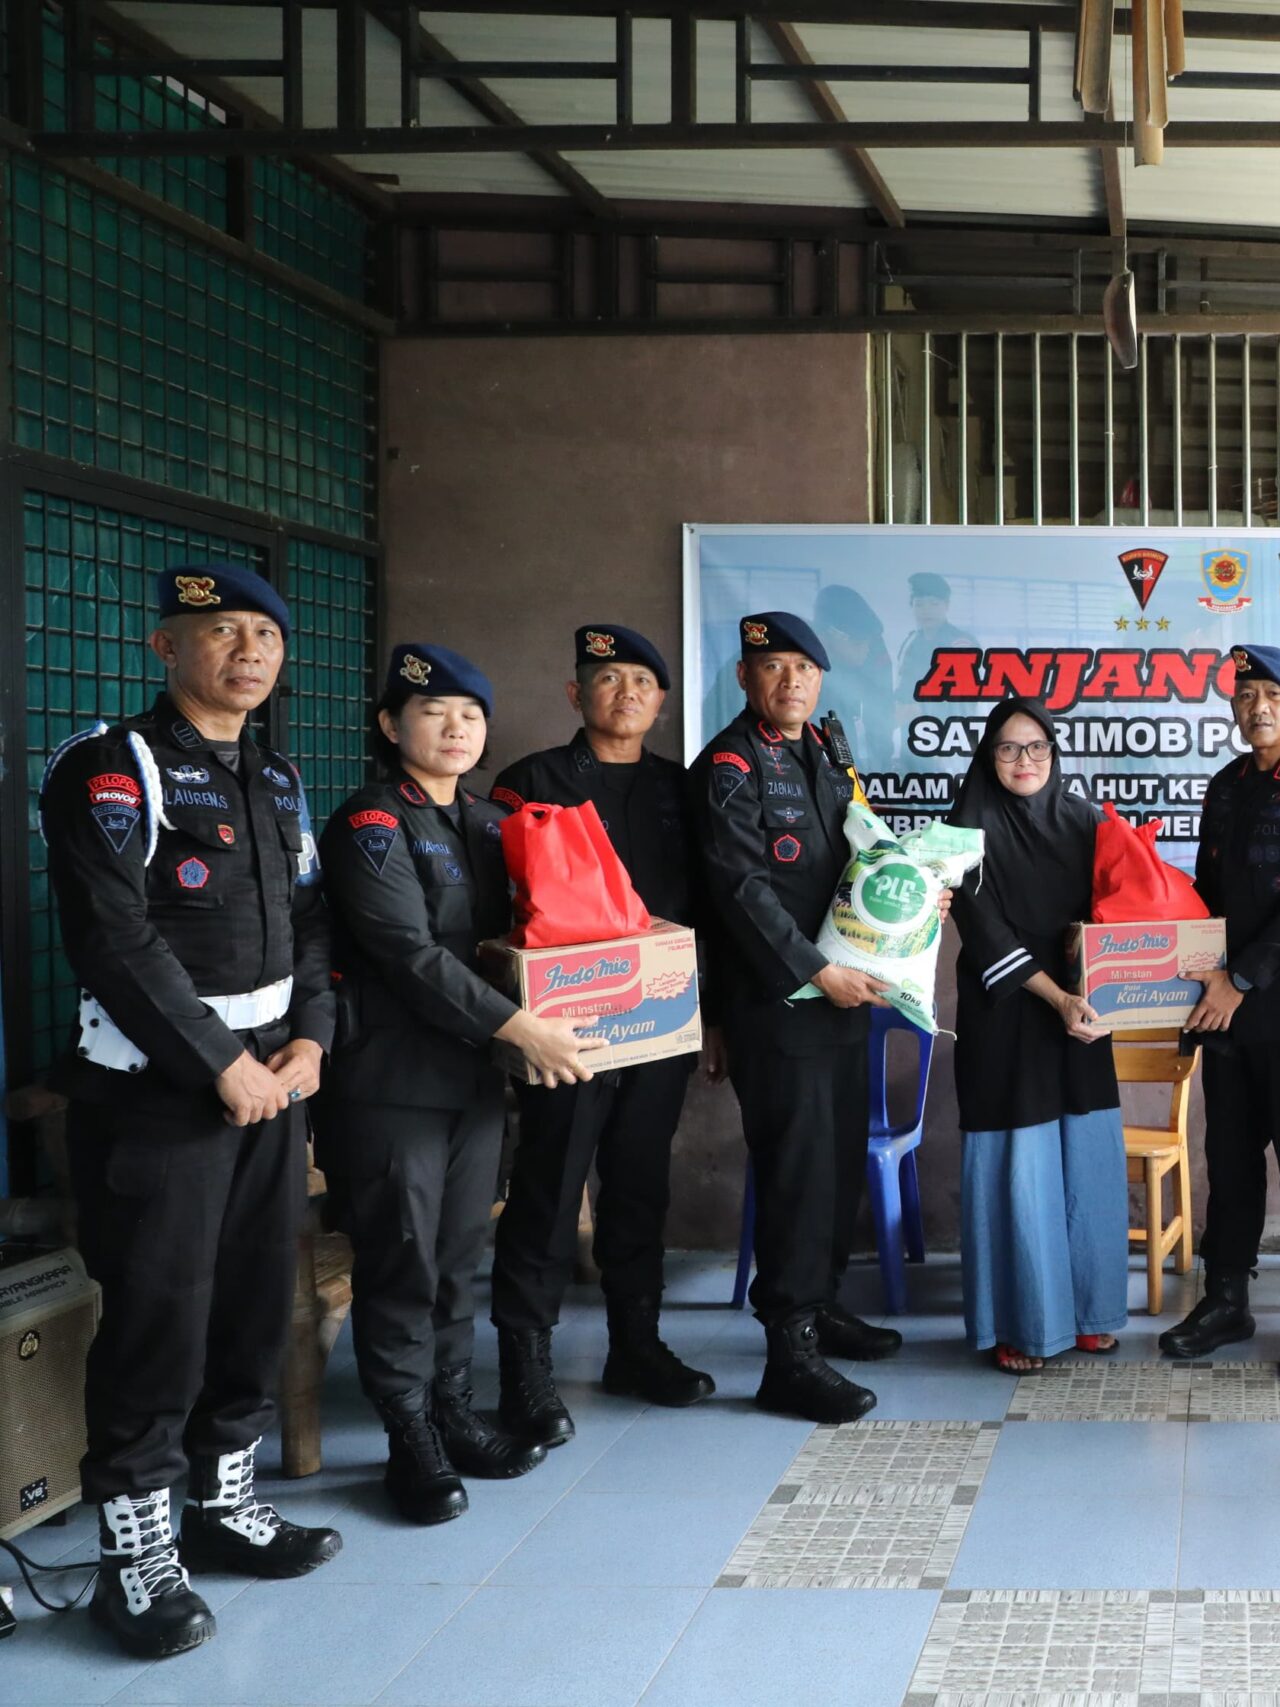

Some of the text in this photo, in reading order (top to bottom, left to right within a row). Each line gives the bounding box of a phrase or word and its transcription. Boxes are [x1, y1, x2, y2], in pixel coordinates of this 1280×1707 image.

[1053, 721, 1188, 753] RIMOB
[862, 778, 949, 799] ALAM
[1096, 779, 1159, 800] HUT
[1116, 989, 1188, 1006] Kari Ayam
[608, 1019, 656, 1043] Ayam
